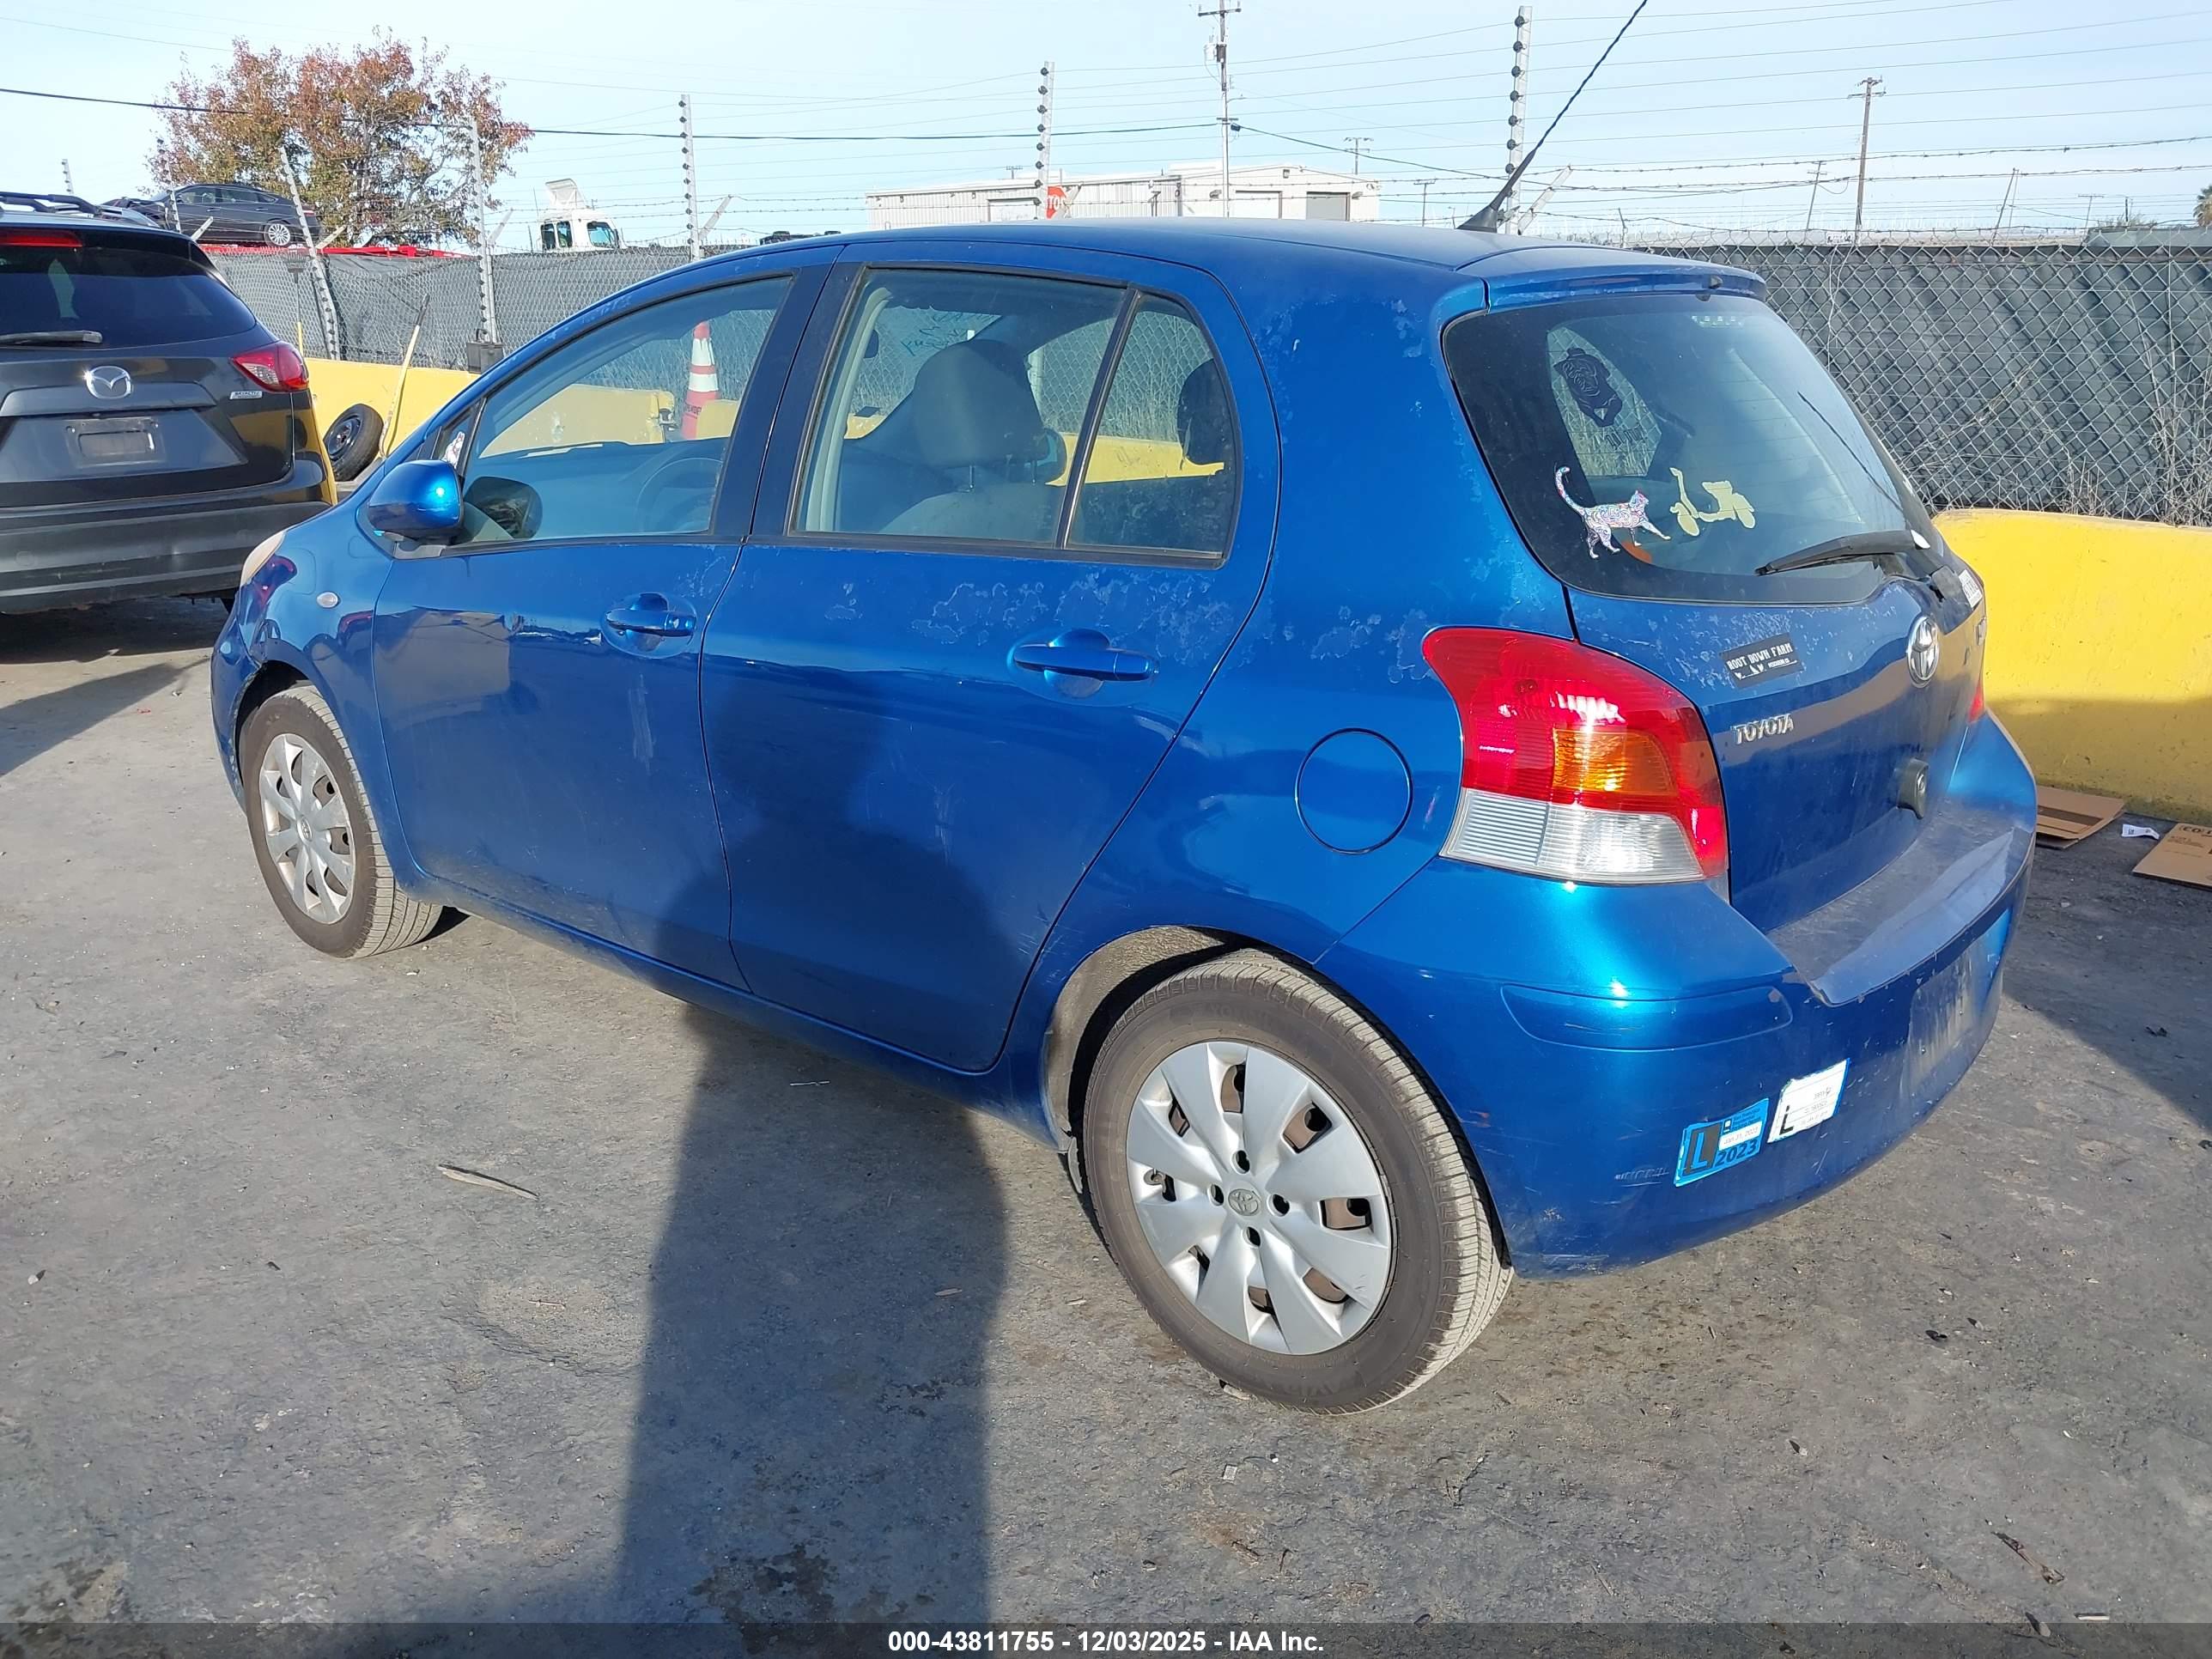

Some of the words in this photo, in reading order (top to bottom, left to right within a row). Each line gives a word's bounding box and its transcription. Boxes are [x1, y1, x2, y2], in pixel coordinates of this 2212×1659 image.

[1726, 656, 1747, 671] ROOT
[1747, 649, 1771, 664] DOWN
[1771, 642, 1793, 656] FARM
[1730, 714, 1794, 744] TOYOTA
[1715, 1139, 1758, 1167] 2023
